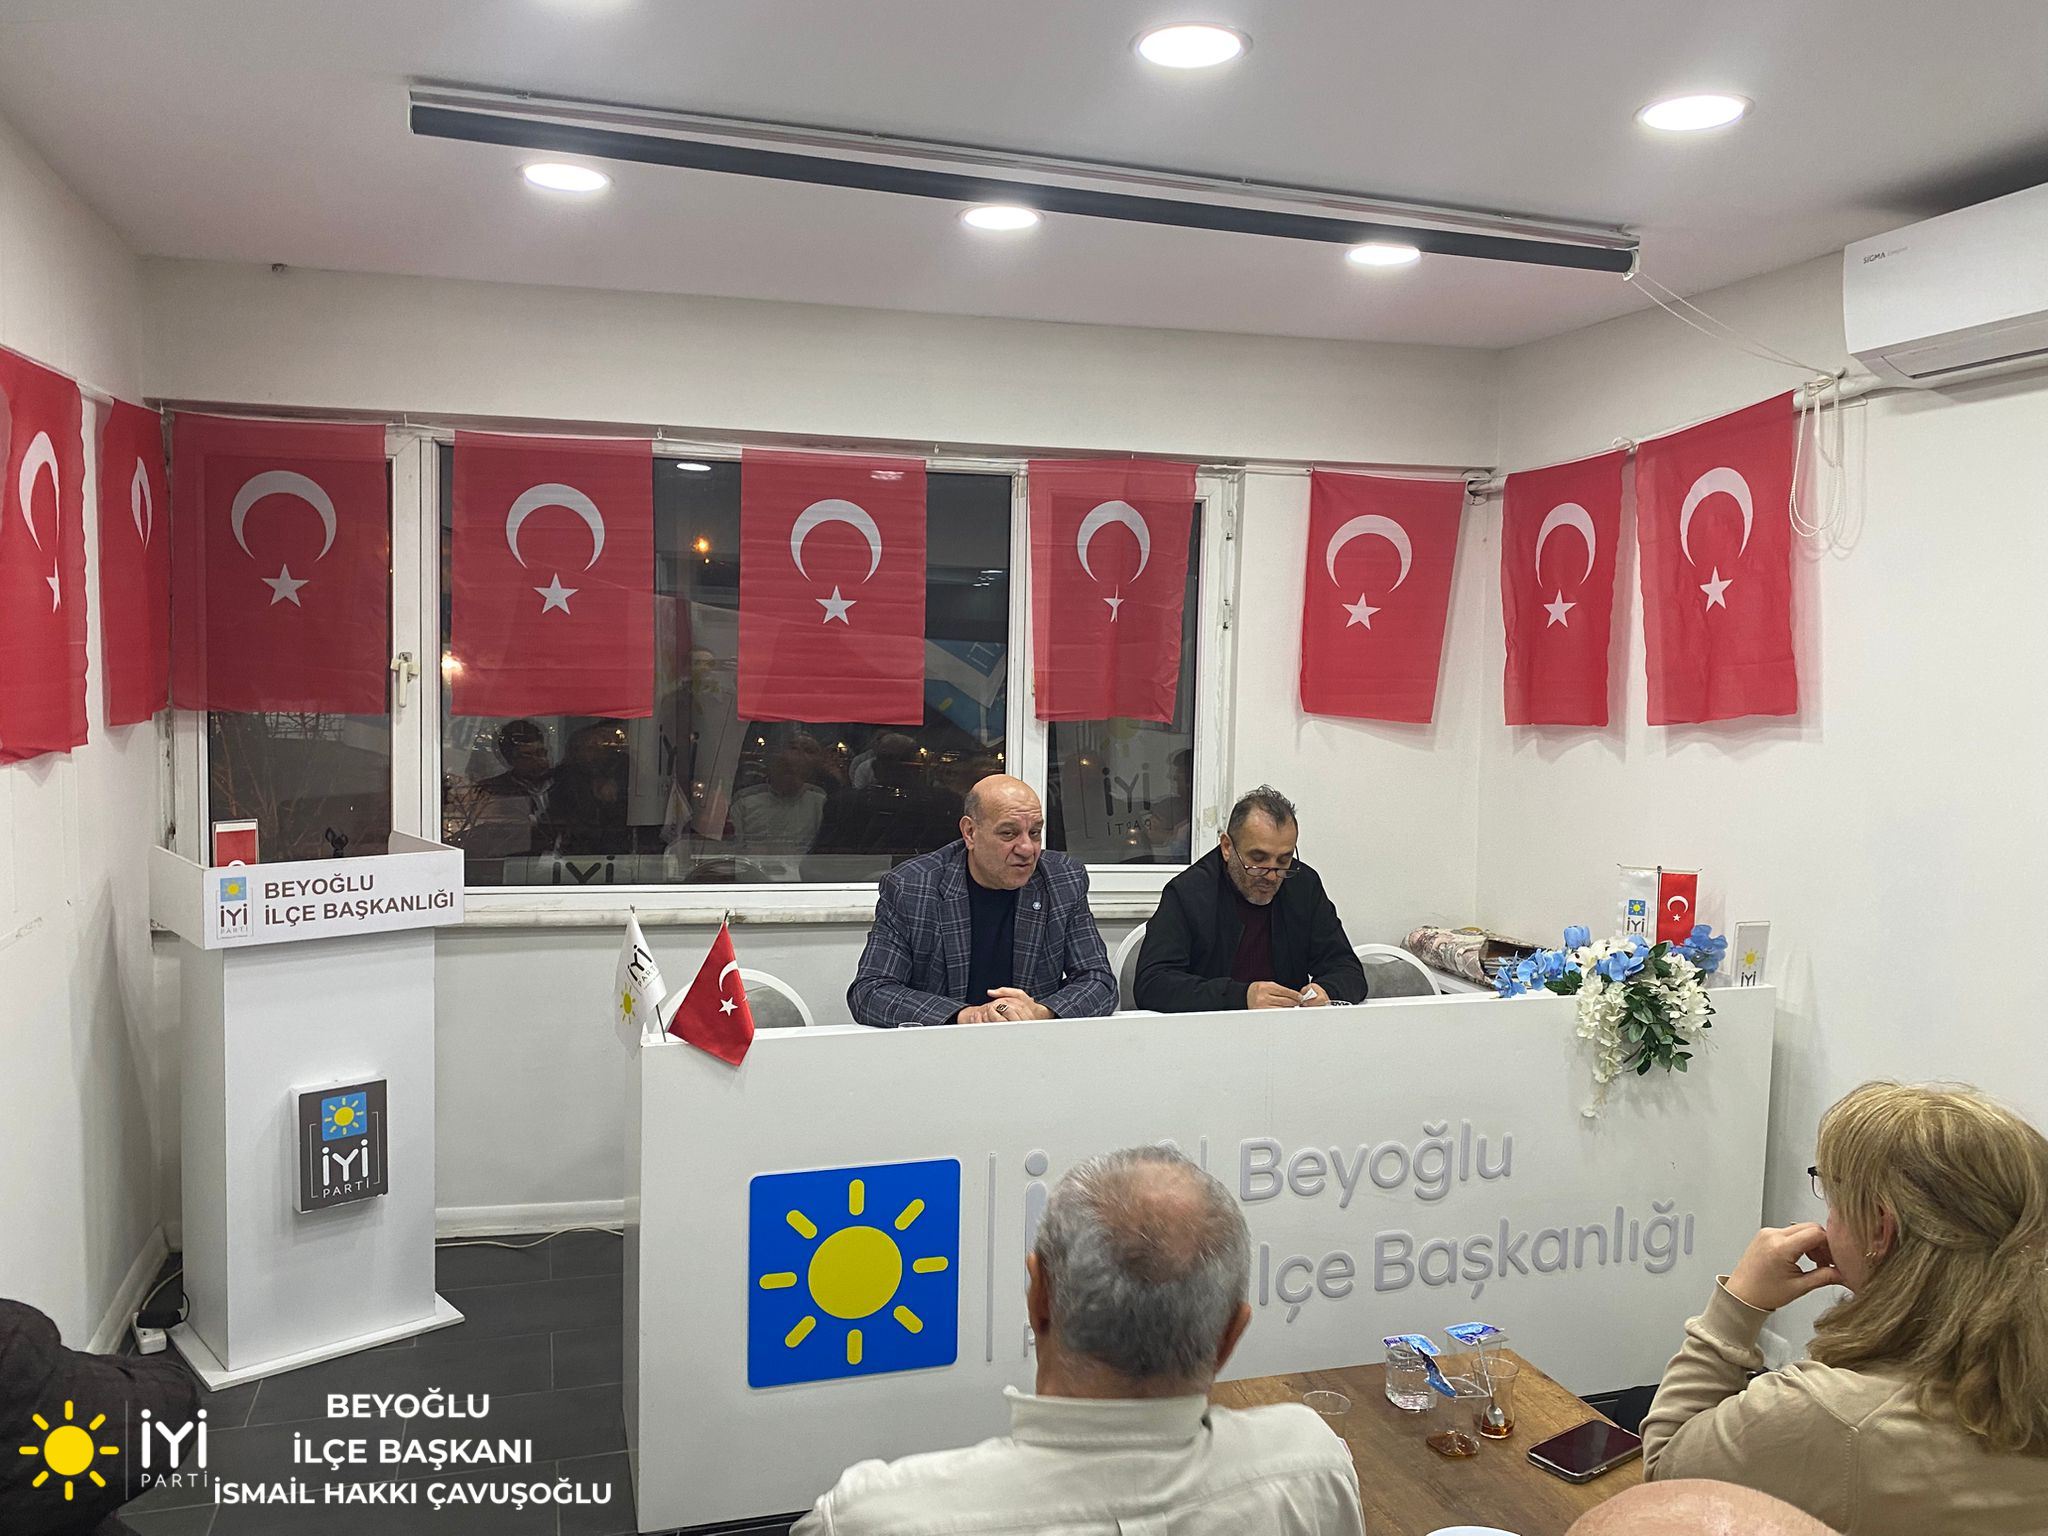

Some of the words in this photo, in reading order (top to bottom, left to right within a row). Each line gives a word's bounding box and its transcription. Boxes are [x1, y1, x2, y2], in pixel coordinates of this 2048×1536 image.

[1863, 251, 1886, 264] SIGMA
[264, 873, 374, 899] BEYOĞLU
[220, 903, 248, 928] İYİ
[265, 904, 316, 927] İLÇE
[323, 888, 454, 921] BAŞKANLIĞI
[321, 1138, 369, 1187] İYİ
[1239, 1117, 1513, 1209] Beyoğlu
[1258, 1241, 1357, 1324] lçe
[1373, 1199, 1695, 1301] Başkanlığı
